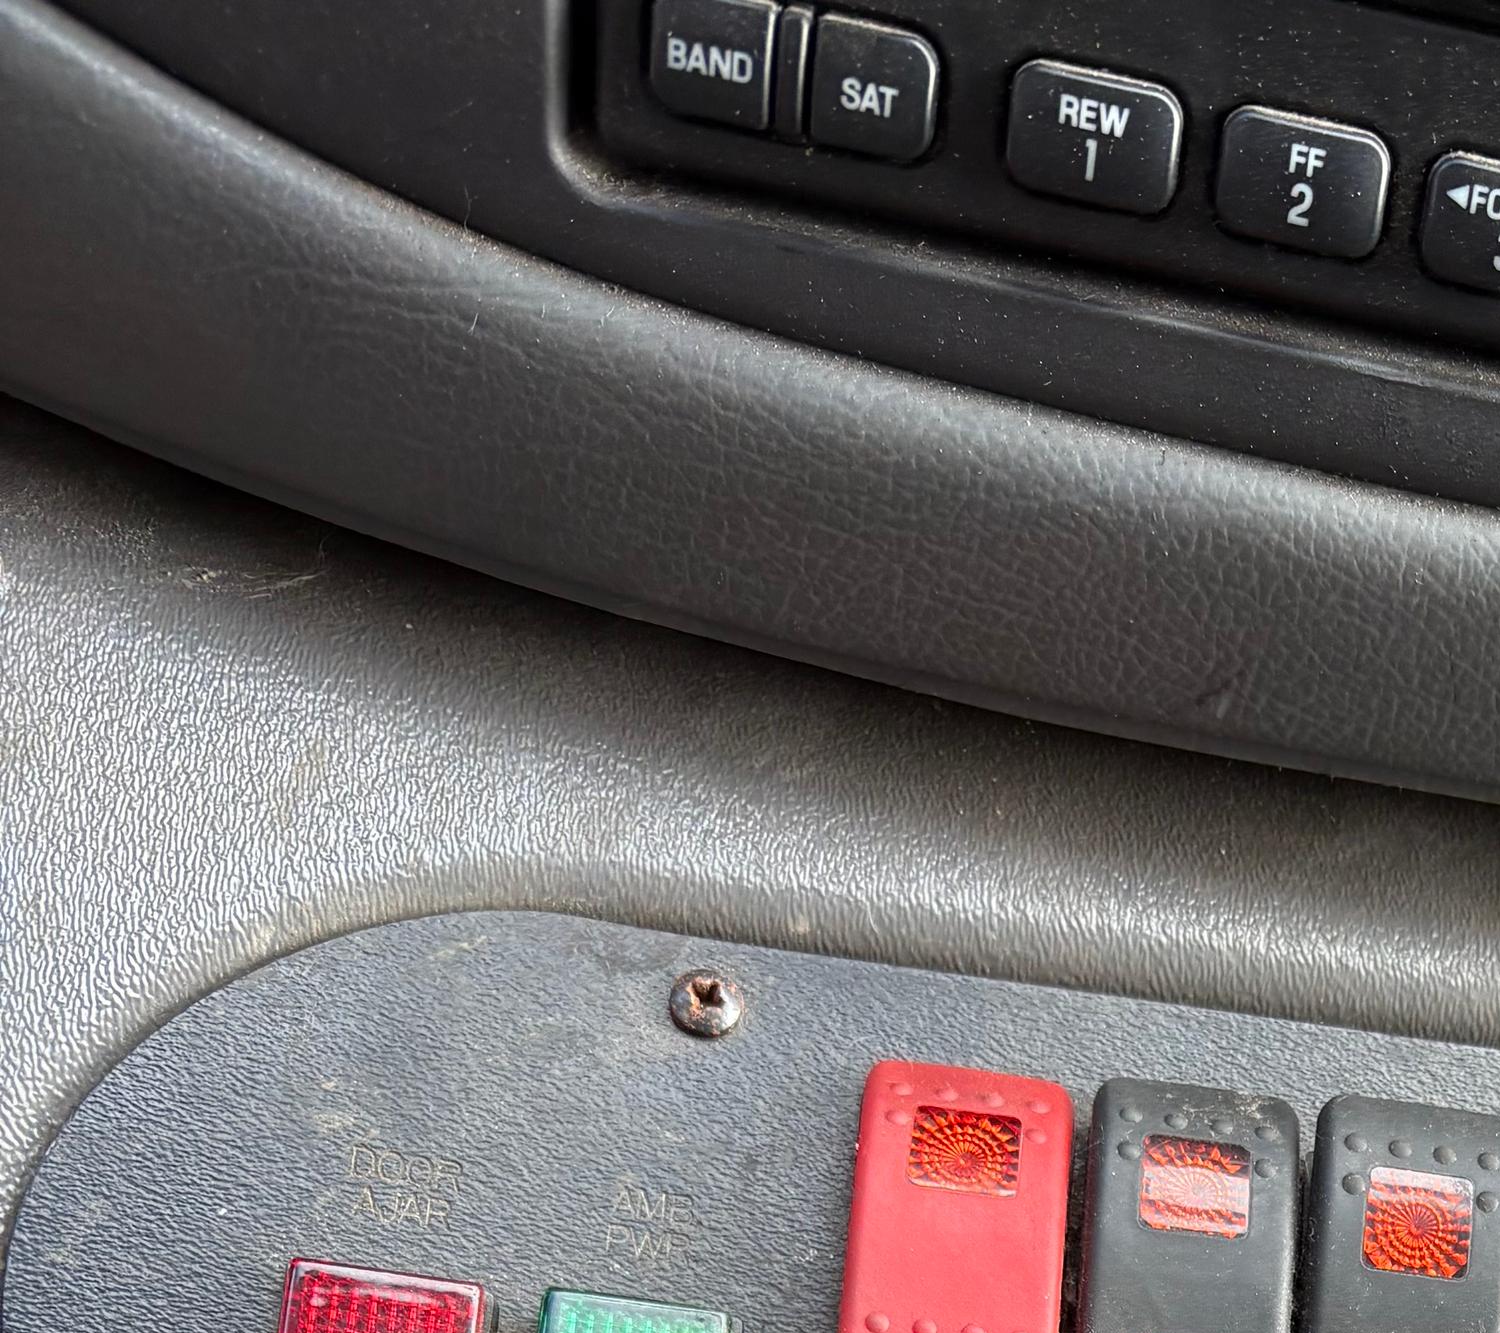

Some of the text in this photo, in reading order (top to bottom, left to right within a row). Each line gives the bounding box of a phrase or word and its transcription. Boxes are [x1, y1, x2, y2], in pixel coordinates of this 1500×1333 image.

[667, 38, 753, 84] BAND
[840, 77, 899, 119] SAT
[1057, 94, 1130, 138] REW
[1084, 138, 1097, 183] 1
[1288, 143, 1327, 178] FF
[1286, 182, 1314, 227] 2
[350, 1143, 463, 1193] DOOR
